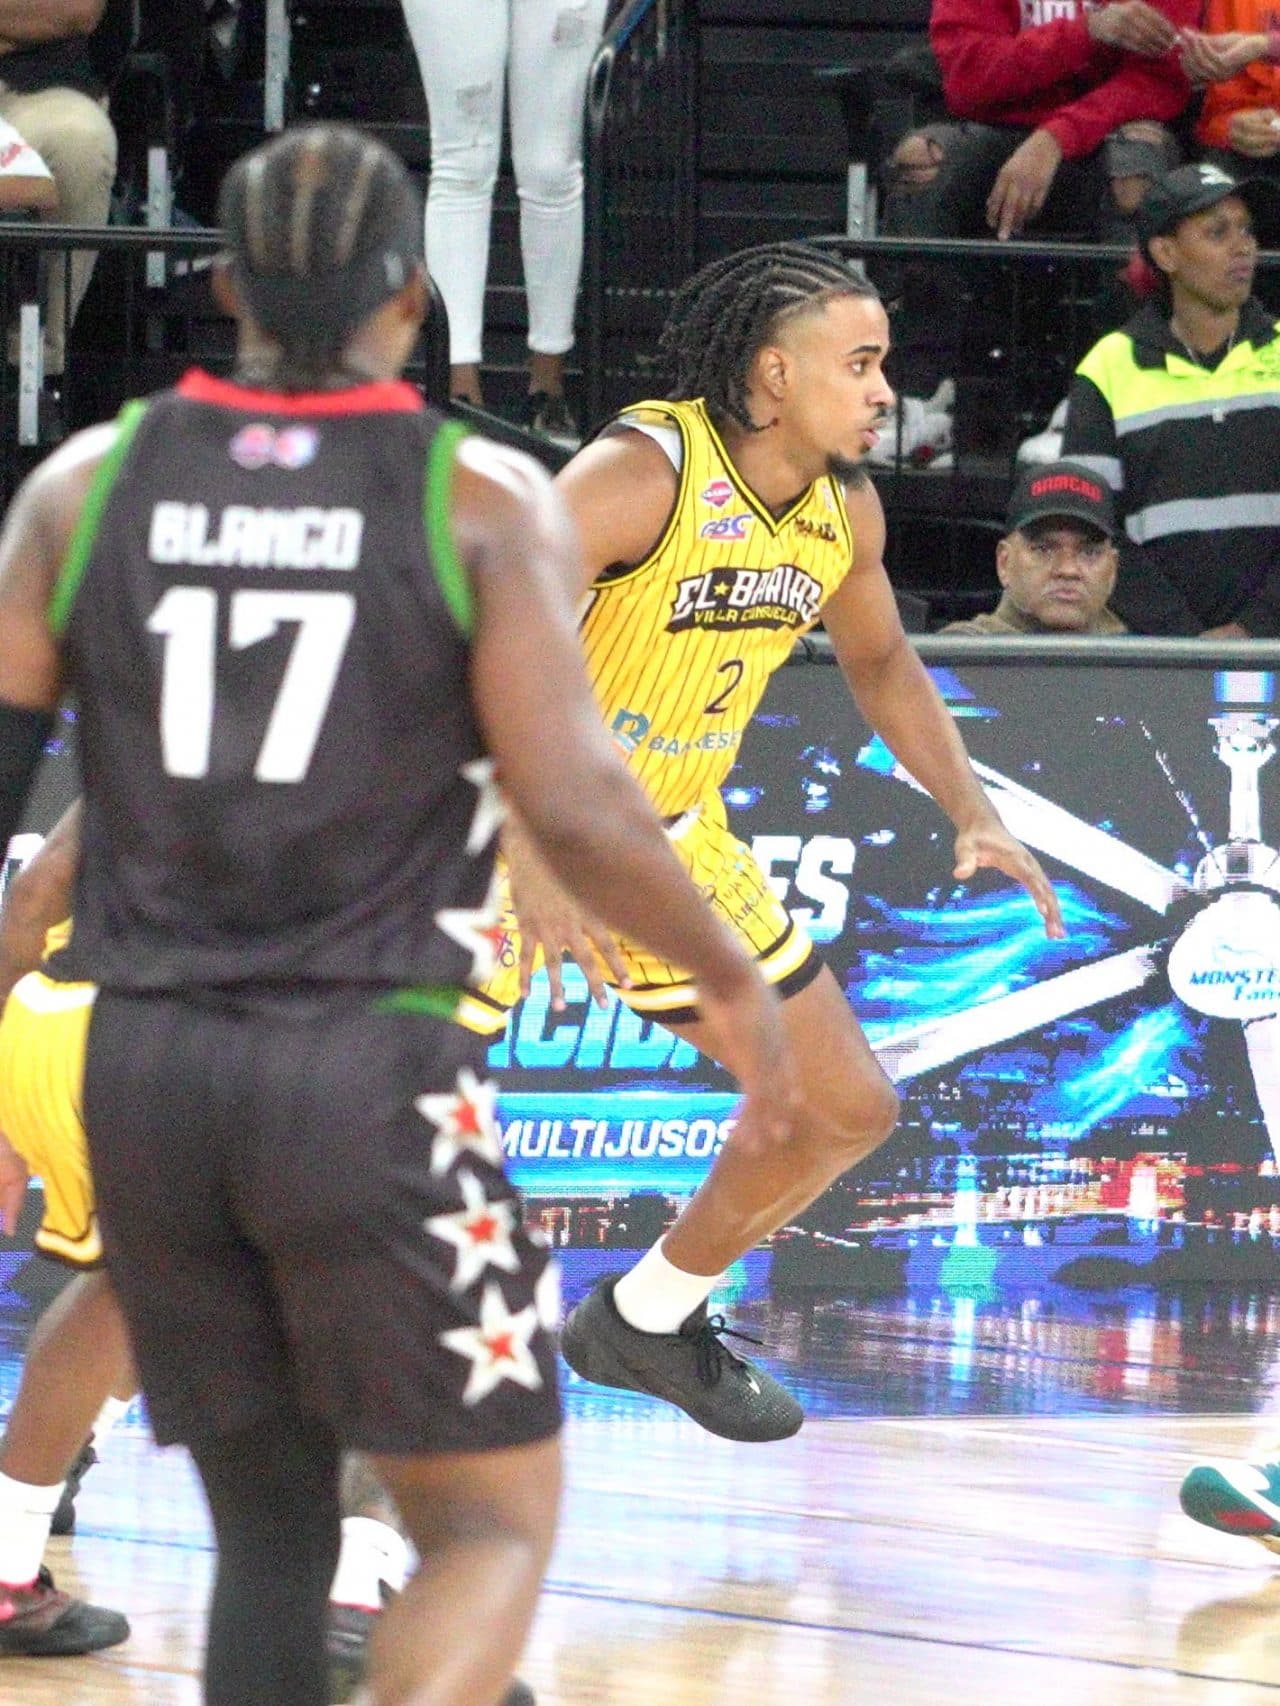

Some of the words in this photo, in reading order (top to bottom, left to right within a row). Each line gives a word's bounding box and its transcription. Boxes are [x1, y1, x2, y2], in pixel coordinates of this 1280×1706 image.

[149, 500, 364, 571] BLANCO
[671, 571, 717, 622] EL
[694, 607, 738, 624] VILLA
[146, 586, 356, 783] 17
[703, 659, 744, 715] 2
